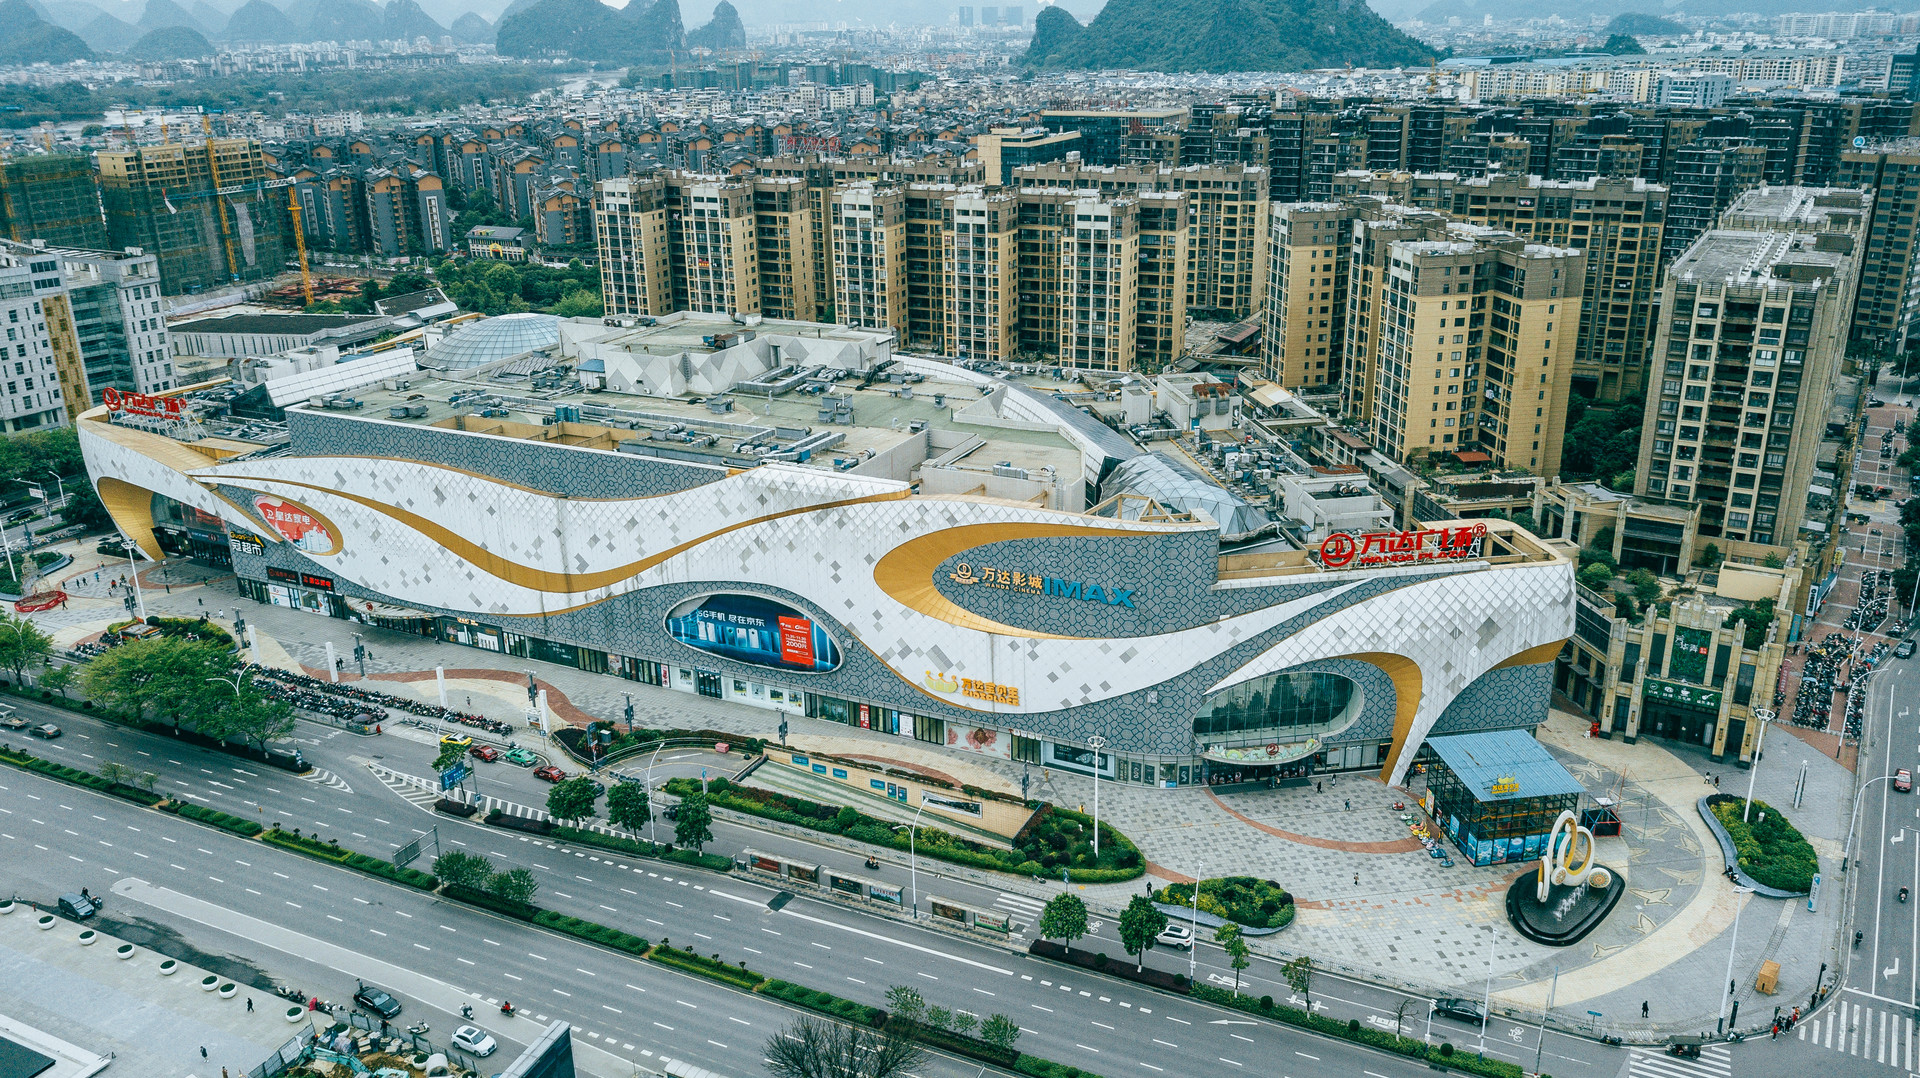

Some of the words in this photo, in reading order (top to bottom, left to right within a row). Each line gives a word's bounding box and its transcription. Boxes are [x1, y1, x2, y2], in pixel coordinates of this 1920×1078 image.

[231, 539, 262, 556] 冠超市
[1360, 526, 1472, 554] 万达广场
[1360, 554, 1414, 564] WANDA
[1418, 549, 1467, 560] PLAZA
[982, 567, 1043, 590] 万达影城
[985, 582, 1010, 590] WANDA
[1013, 587, 1041, 595] CINEMA
[1044, 576, 1136, 609] IMAX
[728, 614, 765, 627] 尽在京东
[961, 678, 1019, 698] 万达宝贝王
